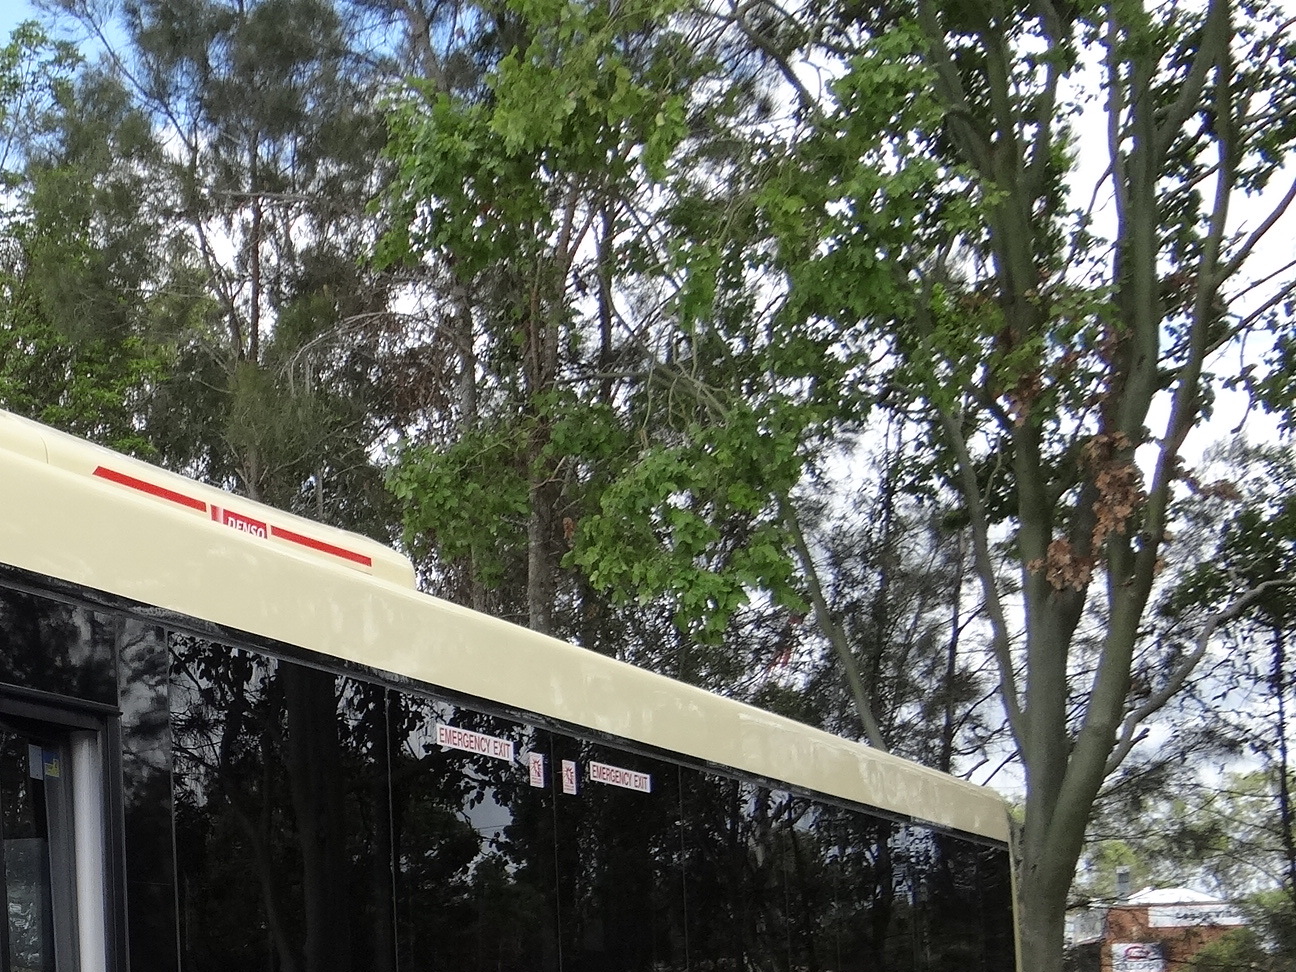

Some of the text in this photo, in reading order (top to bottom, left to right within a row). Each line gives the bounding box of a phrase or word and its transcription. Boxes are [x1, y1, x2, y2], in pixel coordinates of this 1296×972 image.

[227, 516, 266, 538] DENSO
[439, 727, 511, 759] EMERGENCY EXIT
[592, 764, 648, 790] EMERGENCY EXIT
